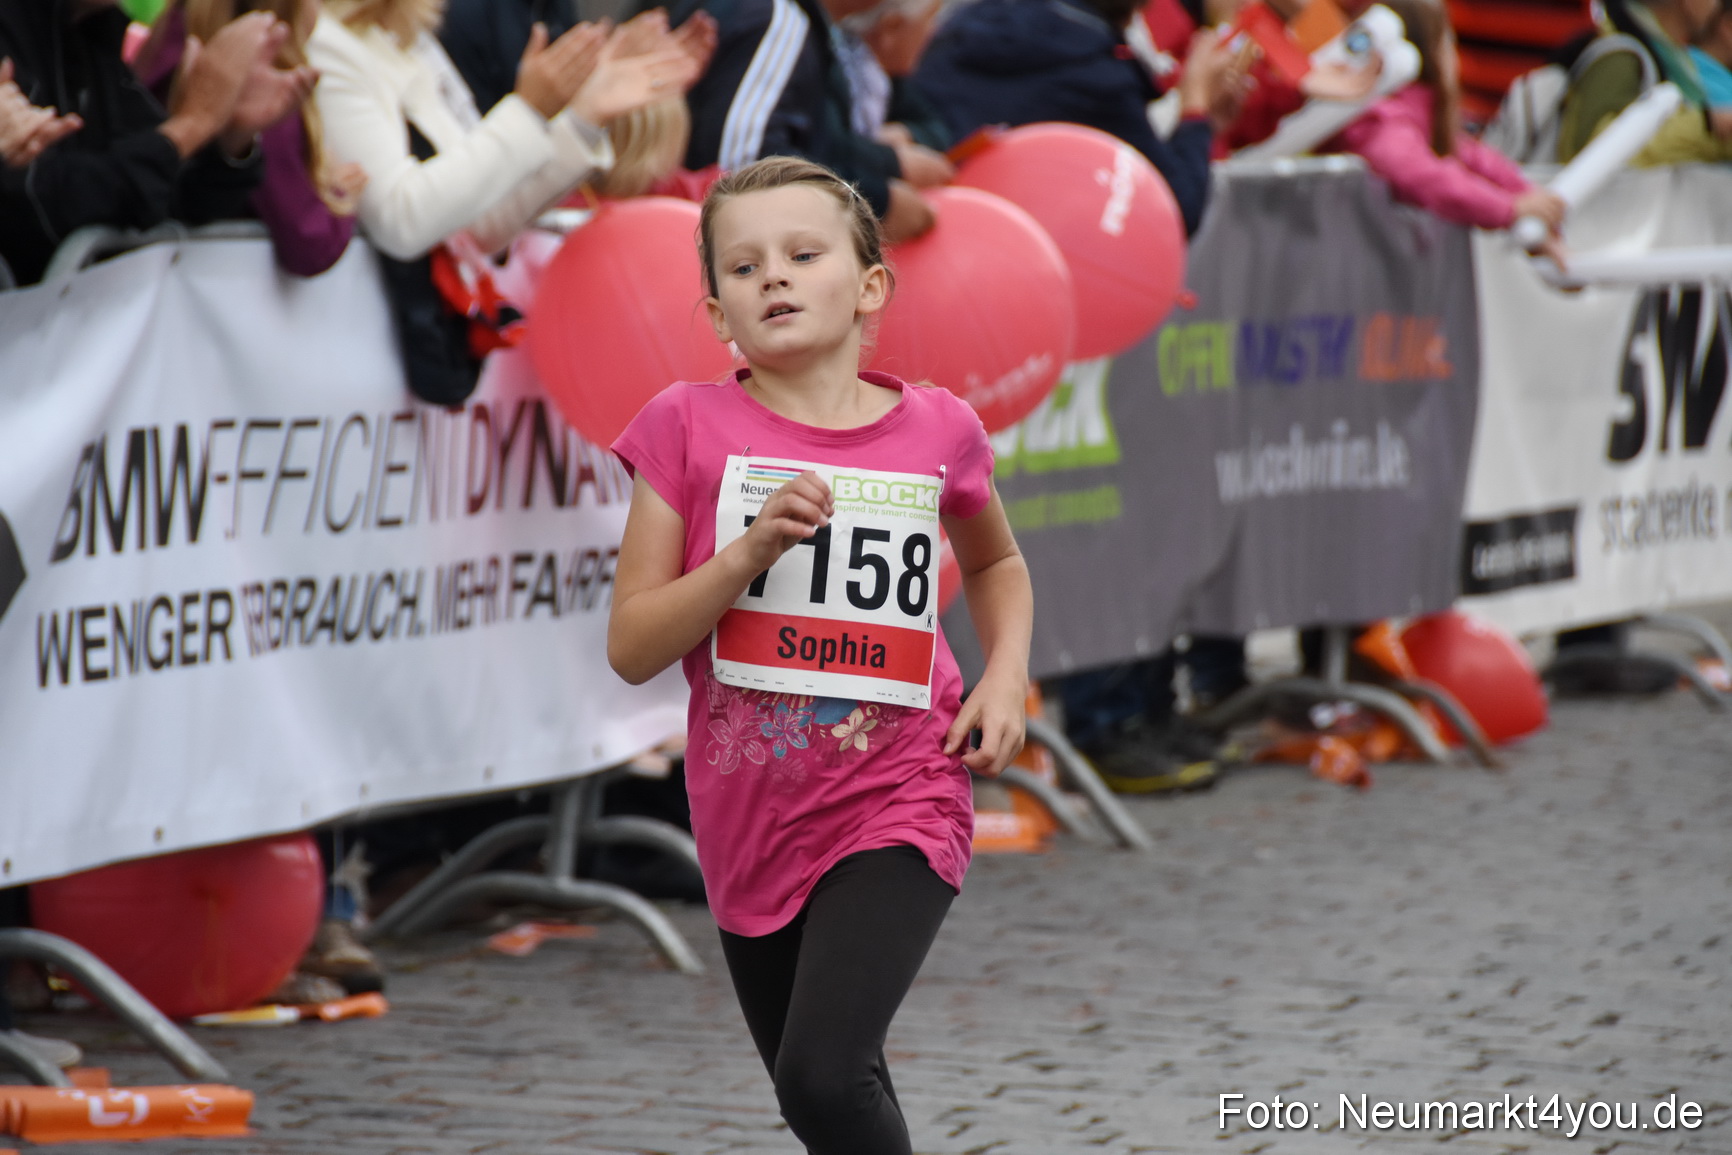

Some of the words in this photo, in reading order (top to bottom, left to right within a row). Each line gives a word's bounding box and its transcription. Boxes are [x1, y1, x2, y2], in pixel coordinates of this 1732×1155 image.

[832, 475, 938, 512] BOCK
[833, 503, 866, 513] nspired
[868, 506, 880, 516] by
[881, 508, 907, 518] smart
[926, 613, 933, 629] K
[777, 626, 886, 670] Sophia
